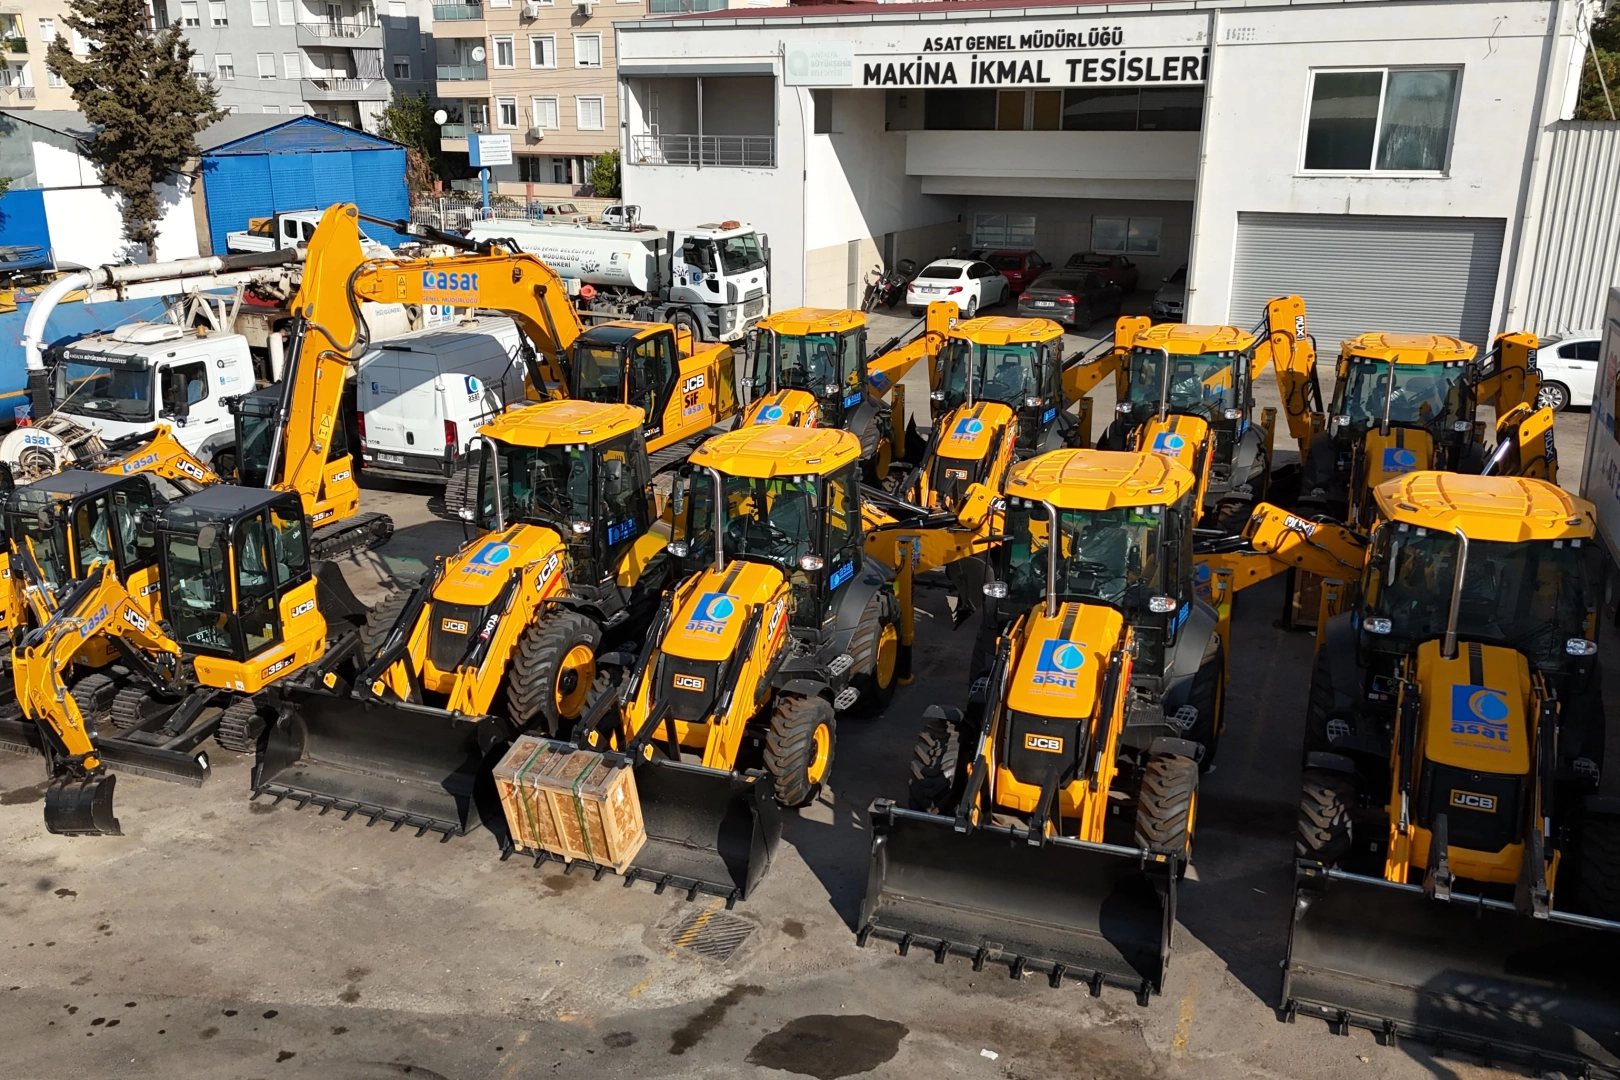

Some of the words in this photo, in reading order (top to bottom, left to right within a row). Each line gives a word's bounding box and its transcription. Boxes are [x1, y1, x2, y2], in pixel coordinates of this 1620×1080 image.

[923, 36, 963, 51] ASAT
[966, 34, 1016, 50] GENEL
[1020, 26, 1123, 49] MÜDÜRLÜĞÜ
[863, 55, 957, 86] MAKİNA
[970, 54, 1051, 85] İKMAL
[1065, 47, 1209, 83] TESİSLERİ
[545, 260, 571, 268] TANKERİ
[437, 272, 479, 291] asat
[683, 374, 704, 393] JCB
[24, 434, 50, 446] asat
[133, 452, 160, 471] asat
[176, 457, 204, 479] JCB
[331, 470, 350, 482] JCB
[536, 554, 559, 592] JCB
[88, 603, 109, 630] asat
[291, 599, 315, 617] JCB
[123, 607, 146, 633] JCB
[443, 620, 466, 632] JCB
[684, 622, 724, 635] asat
[676, 677, 702, 689] JCB
[1032, 675, 1077, 689] asat
[1450, 724, 1509, 742] asat
[1028, 737, 1060, 750] JCB
[1454, 794, 1493, 809] JCB
